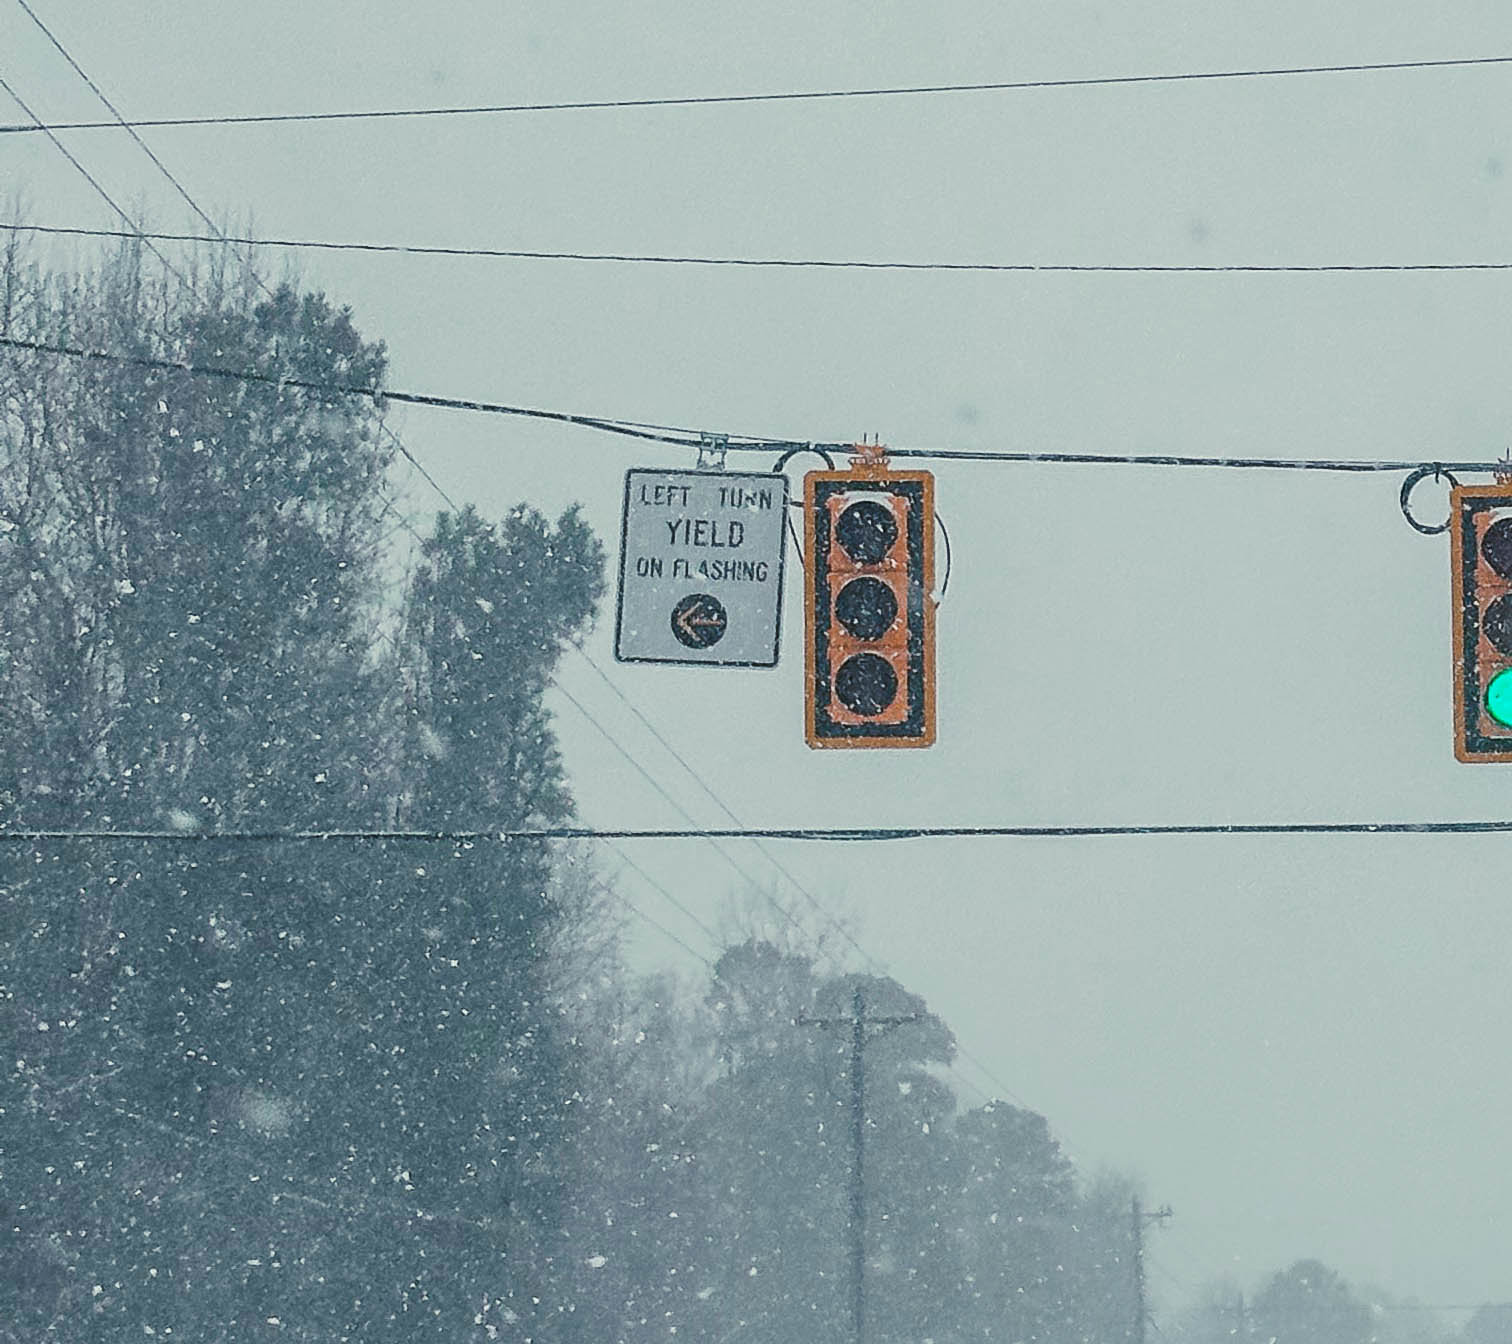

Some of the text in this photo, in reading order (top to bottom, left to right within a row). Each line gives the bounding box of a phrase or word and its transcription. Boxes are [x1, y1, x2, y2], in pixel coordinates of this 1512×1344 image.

[641, 484, 692, 507] LEFT
[666, 519, 745, 548] YIELD
[636, 557, 769, 582] ON FLASHING
